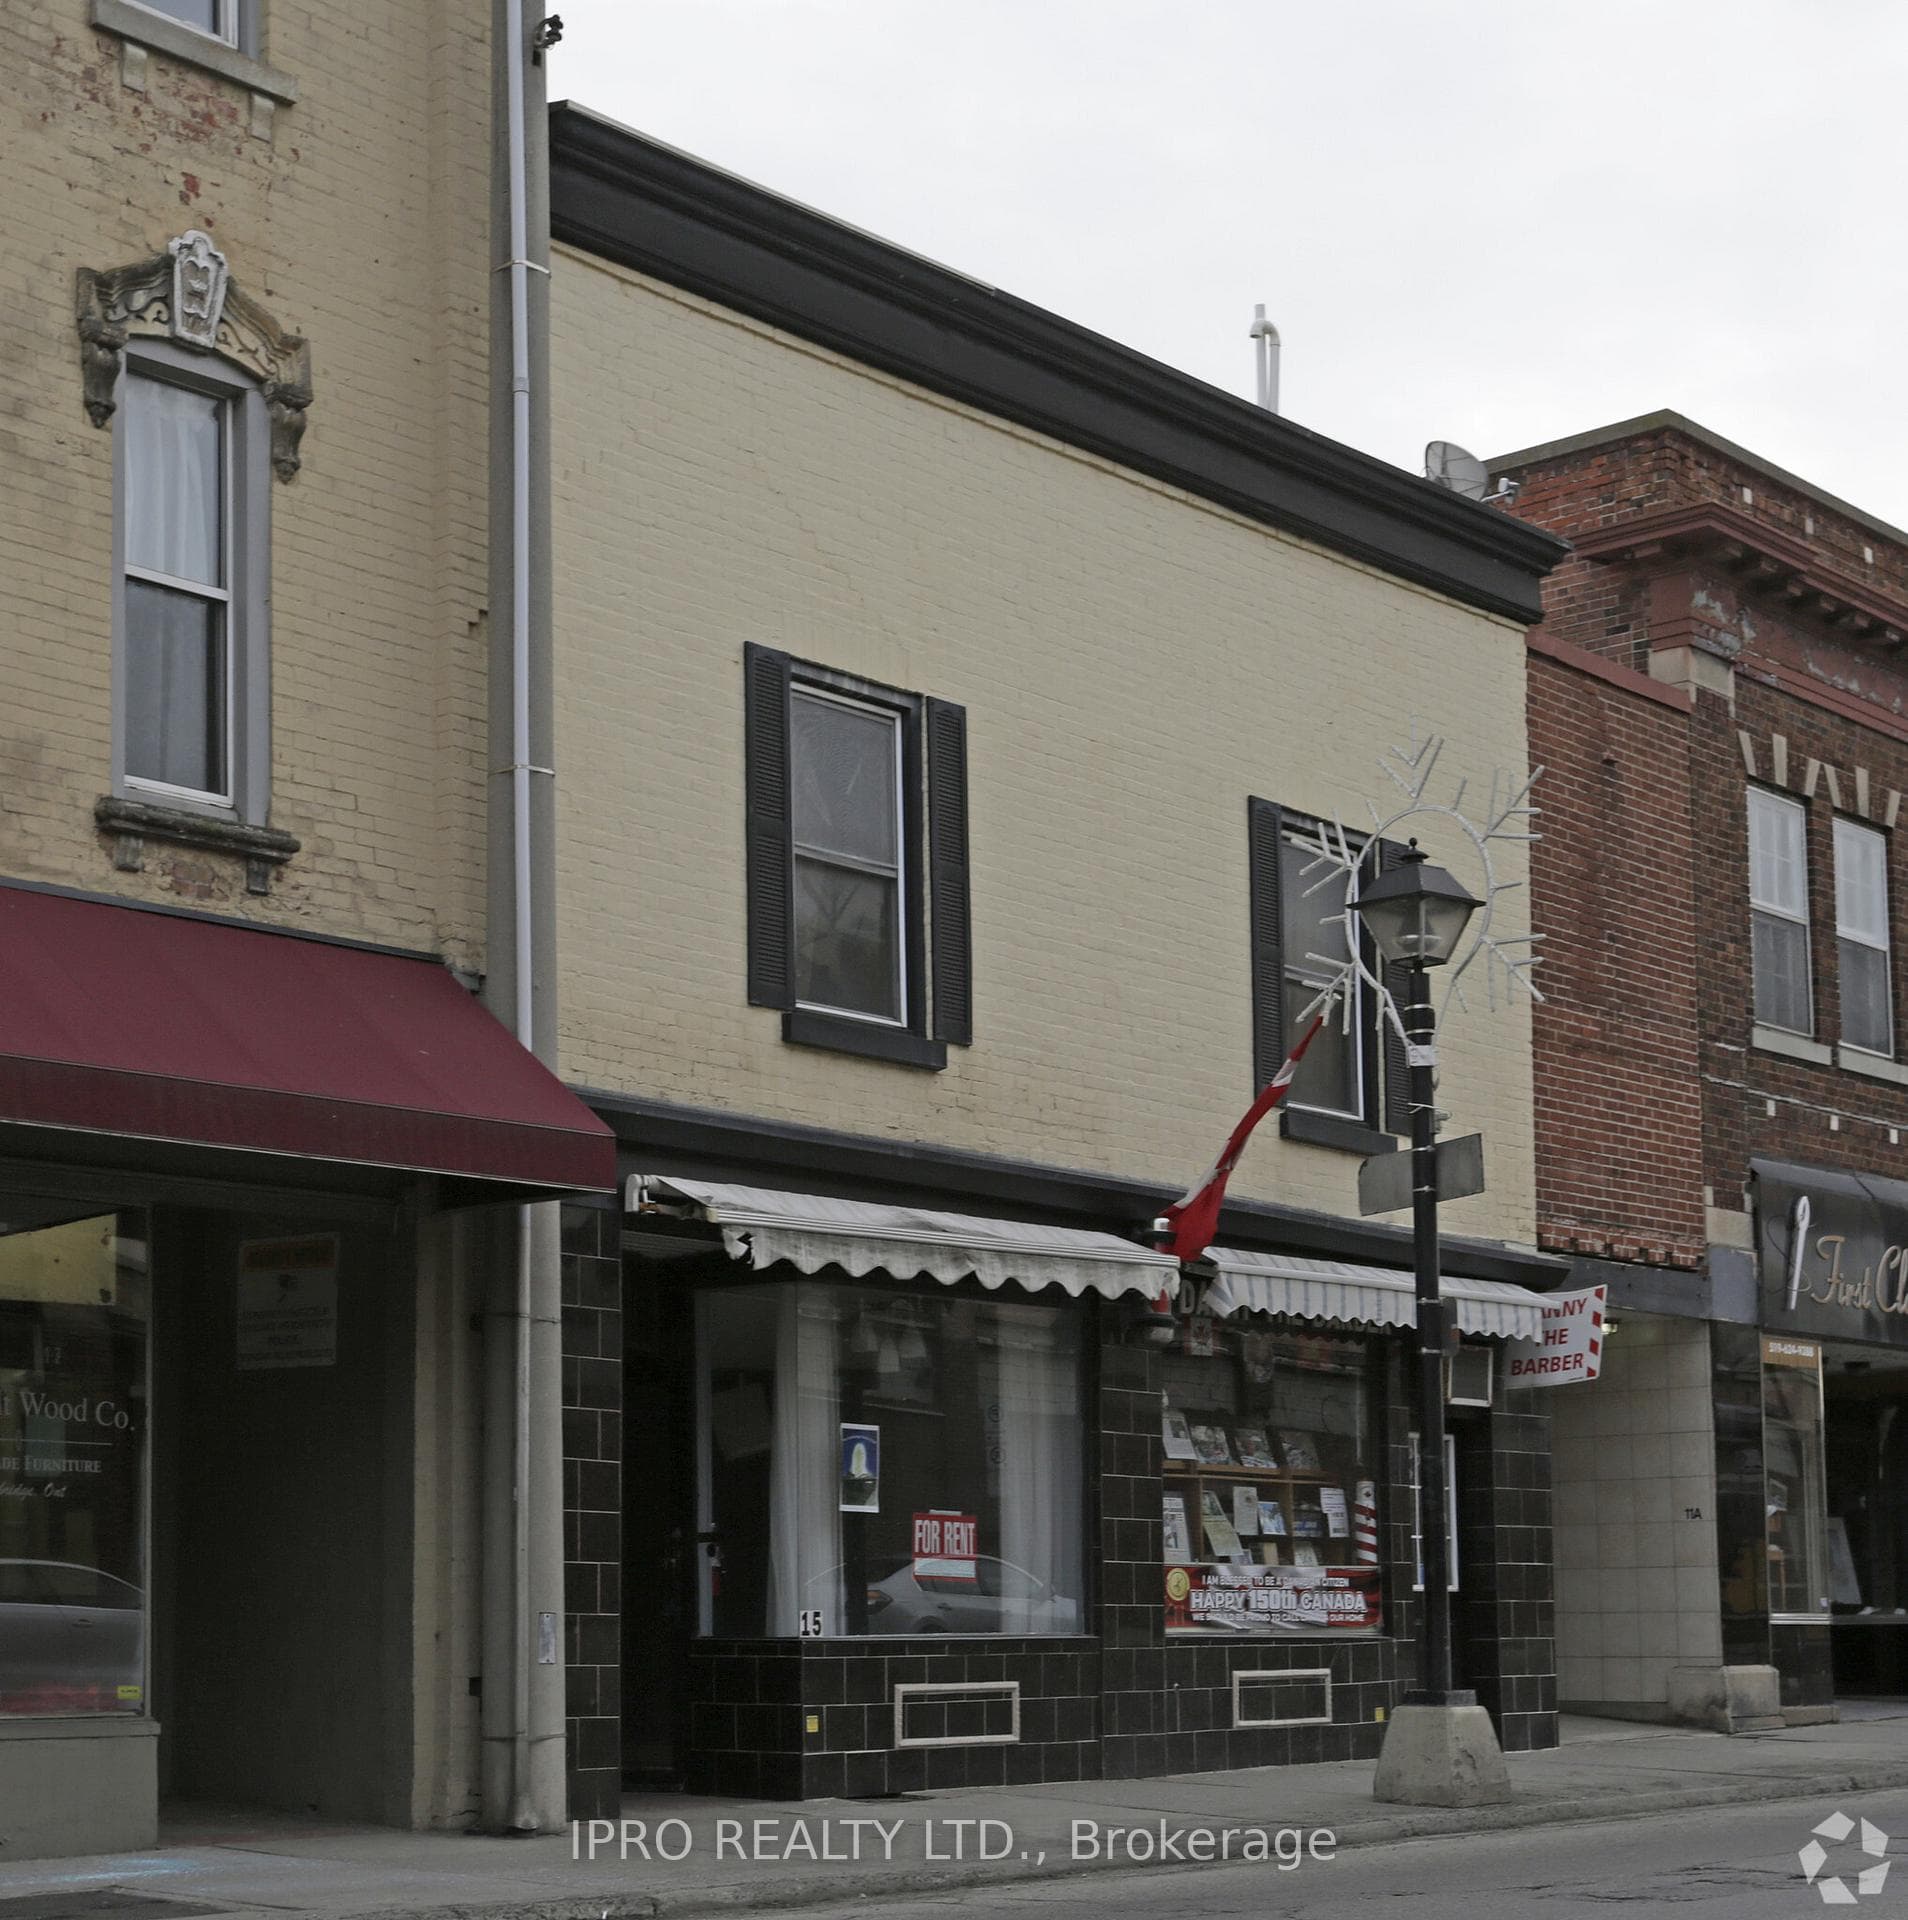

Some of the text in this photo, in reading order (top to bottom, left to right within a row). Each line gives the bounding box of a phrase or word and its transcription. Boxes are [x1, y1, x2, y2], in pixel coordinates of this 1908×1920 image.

[1811, 1234, 1873, 1310] First
[1510, 1352, 1584, 1376] BARBER
[20, 1391, 88, 1422] Wood
[95, 1400, 136, 1430] Co.
[24, 1455, 102, 1473] FURNITURE
[1685, 1508, 1703, 1519] 11A
[914, 1519, 975, 1556] FOR RENT
[1201, 1574, 1206, 1585] I
[1206, 1575, 1219, 1585] AM
[1253, 1576, 1264, 1585] TO
[1265, 1576, 1275, 1586] BE
[1190, 1588, 1368, 1612] HAPPY 150th CANADA
[801, 1611, 821, 1636] 15
[1192, 1612, 1206, 1621] WE
[1271, 1613, 1281, 1622] TO
[1329, 1613, 1344, 1622] OUR
[1344, 1613, 1365, 1622] HOME
